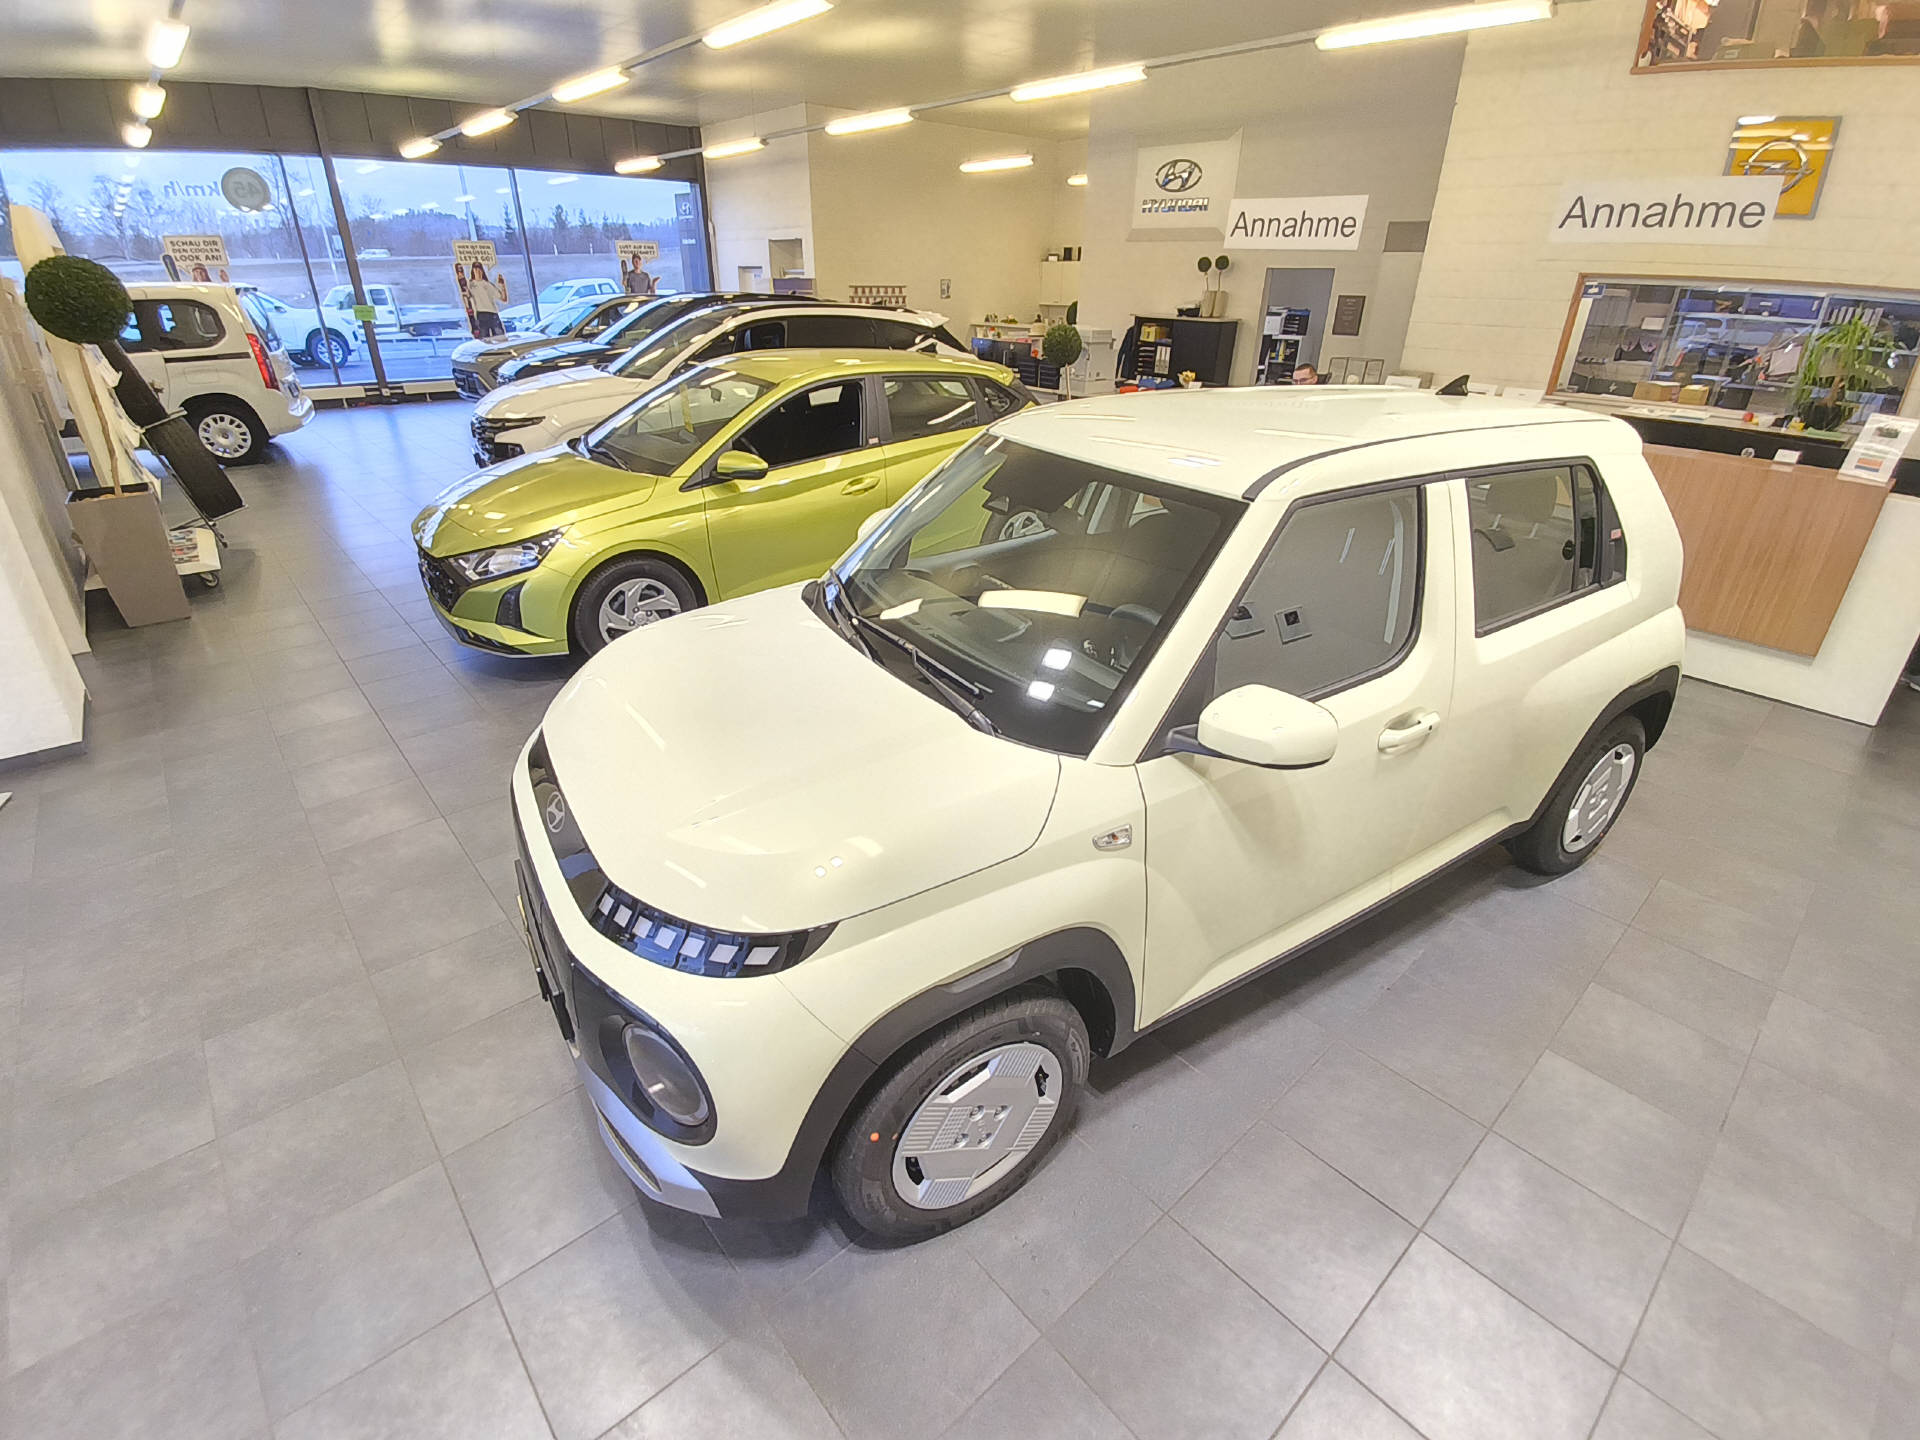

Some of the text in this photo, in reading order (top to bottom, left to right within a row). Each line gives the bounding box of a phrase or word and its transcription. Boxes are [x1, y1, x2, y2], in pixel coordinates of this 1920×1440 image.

[1142, 197, 1210, 213] HYUNDAI
[1558, 193, 1766, 229] Annahme
[1230, 210, 1357, 238] Annahme
[174, 254, 202, 262] LOOK
